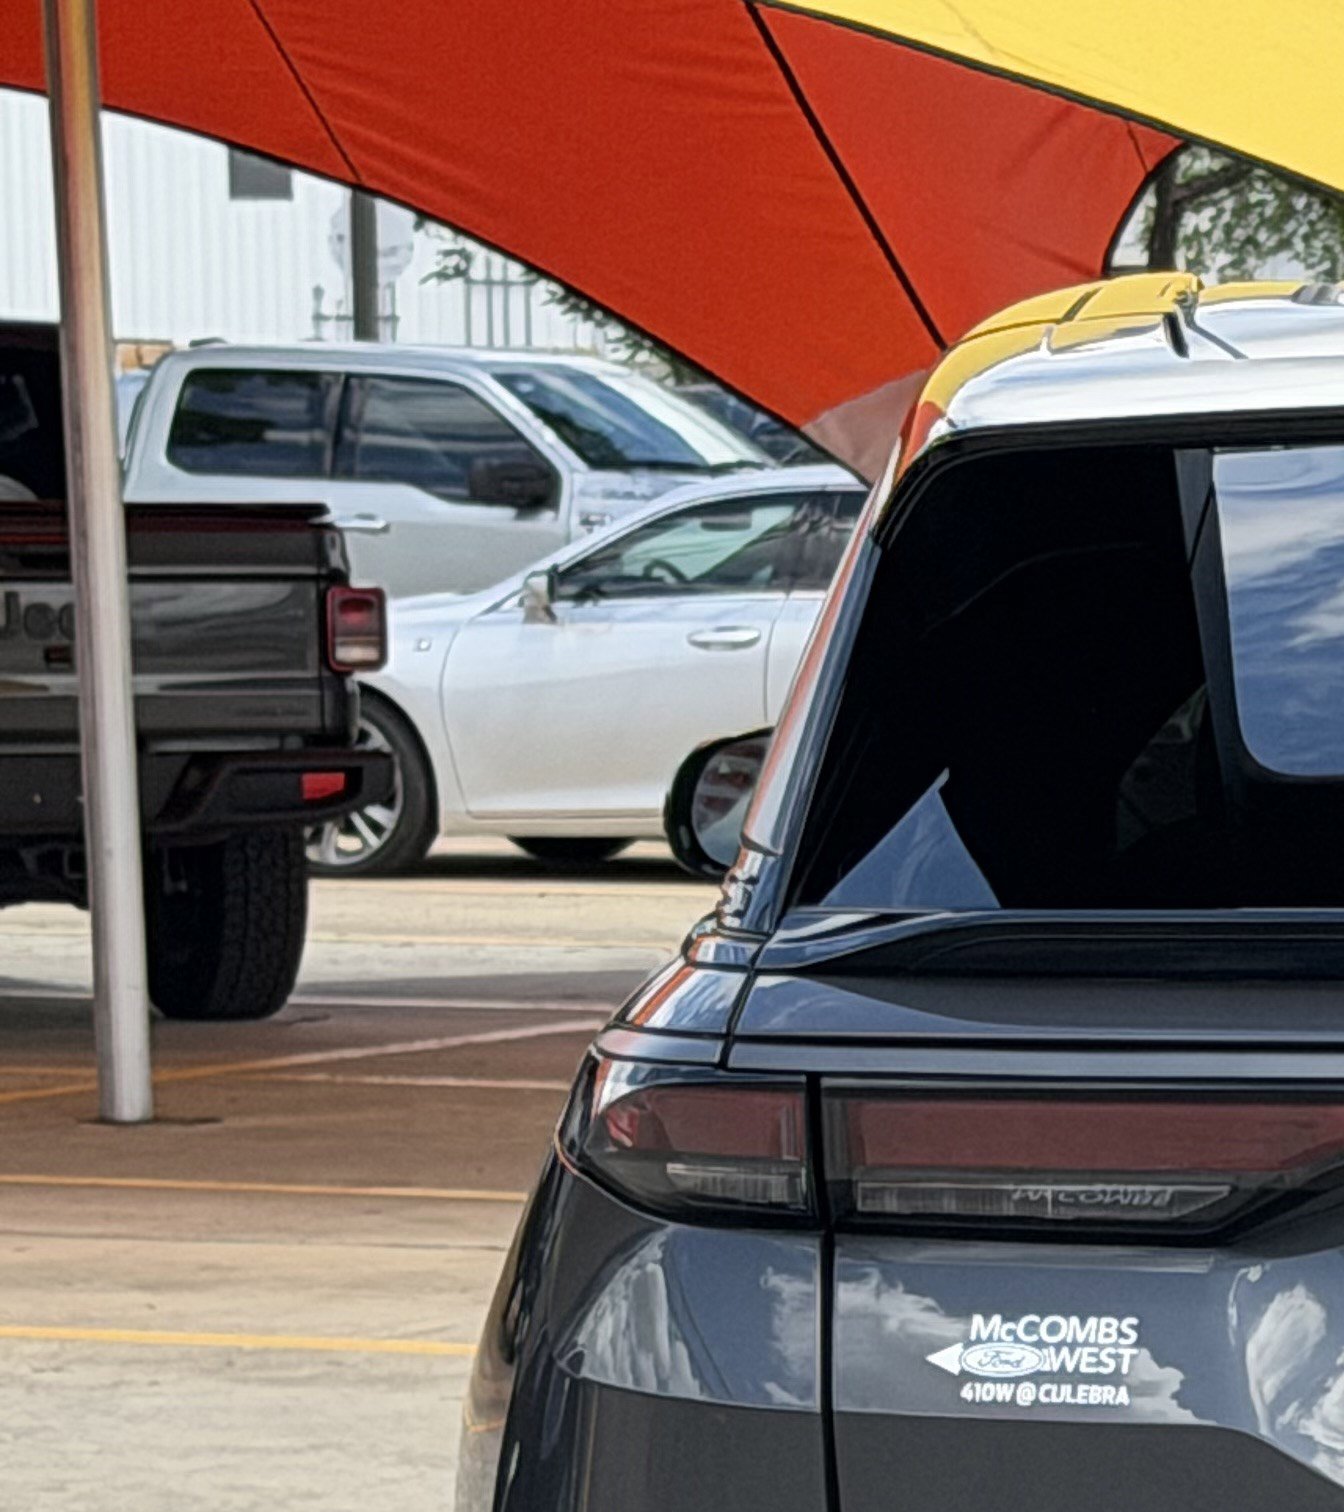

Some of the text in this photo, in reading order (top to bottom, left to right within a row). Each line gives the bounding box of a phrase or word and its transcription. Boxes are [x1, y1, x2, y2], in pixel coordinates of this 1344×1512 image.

[970, 1314, 1139, 1345] McCOMBS
[1046, 1346, 1138, 1375] WEST
[1038, 1383, 1130, 1405] CULEBRA
